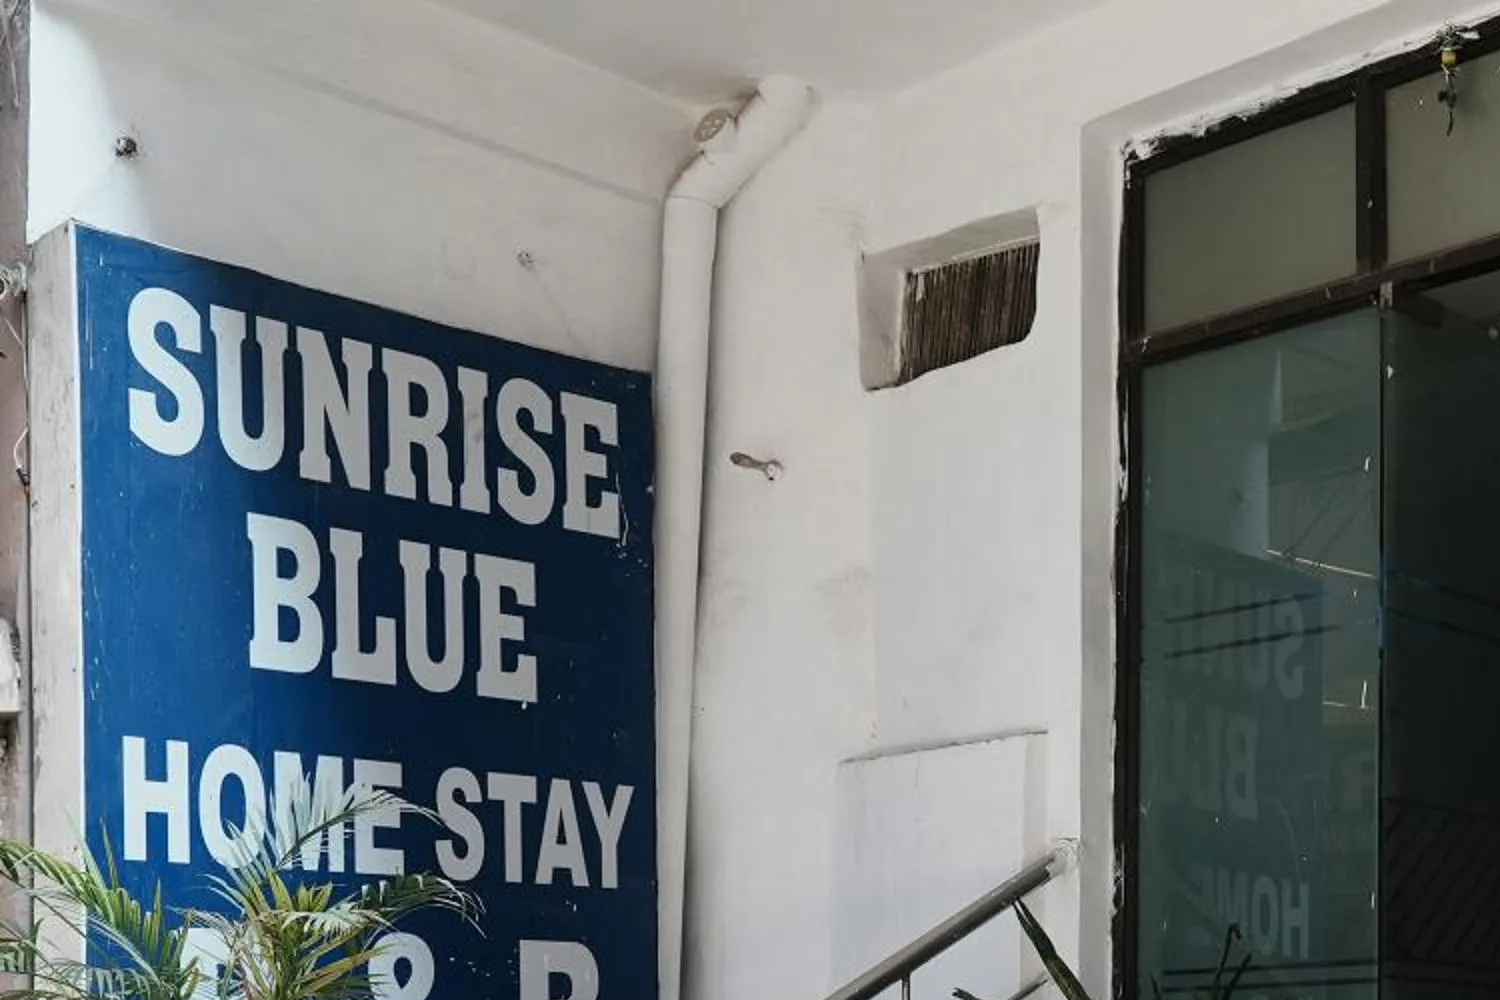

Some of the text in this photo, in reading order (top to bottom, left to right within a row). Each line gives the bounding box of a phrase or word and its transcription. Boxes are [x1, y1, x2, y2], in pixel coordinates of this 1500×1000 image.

[127, 286, 622, 541] SUNRISE
[248, 512, 539, 704] BLUE
[122, 735, 635, 890] HOME STAY
